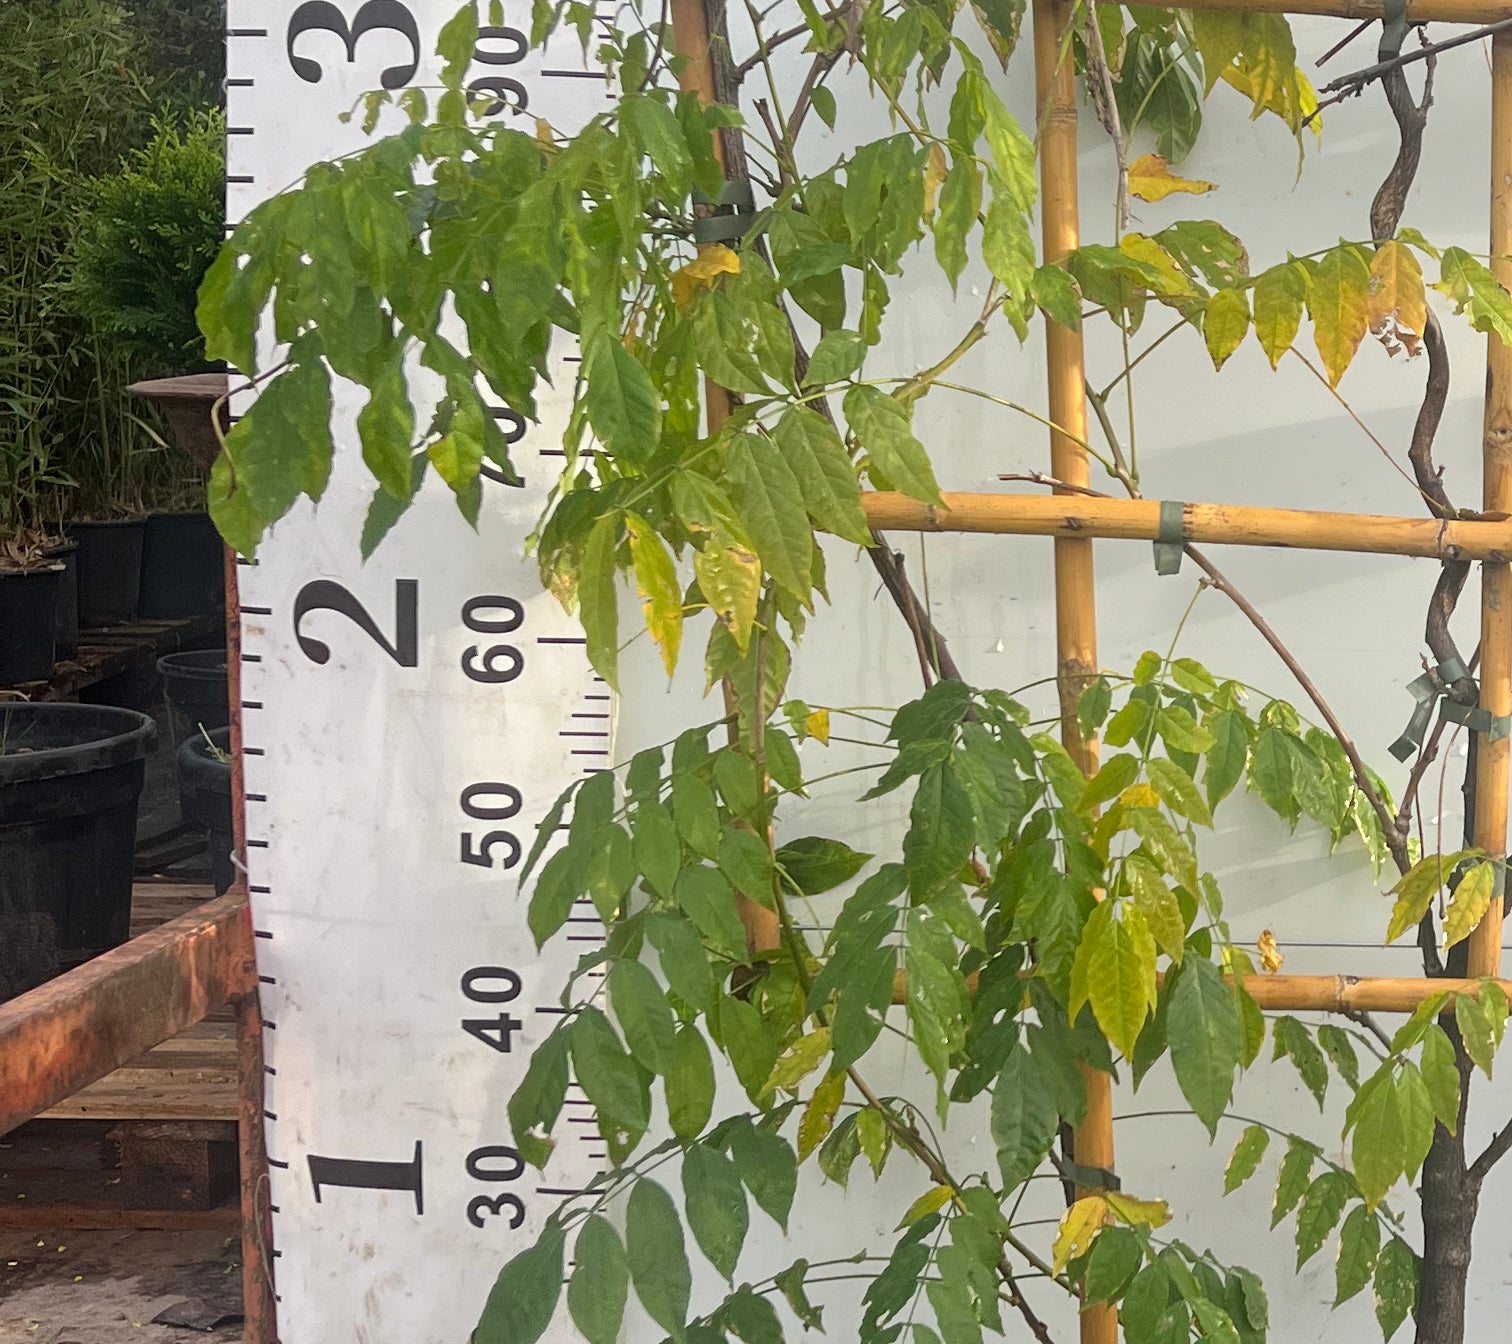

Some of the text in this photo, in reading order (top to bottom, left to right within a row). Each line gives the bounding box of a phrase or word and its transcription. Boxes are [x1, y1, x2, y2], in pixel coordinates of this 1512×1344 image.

[466, 26, 528, 116] 90
[293, 578, 419, 668] 2
[461, 595, 524, 684] 60
[460, 782, 523, 870] 50
[461, 966, 523, 1053] 40
[306, 1140, 424, 1216] 1
[465, 1145, 527, 1230] 30
